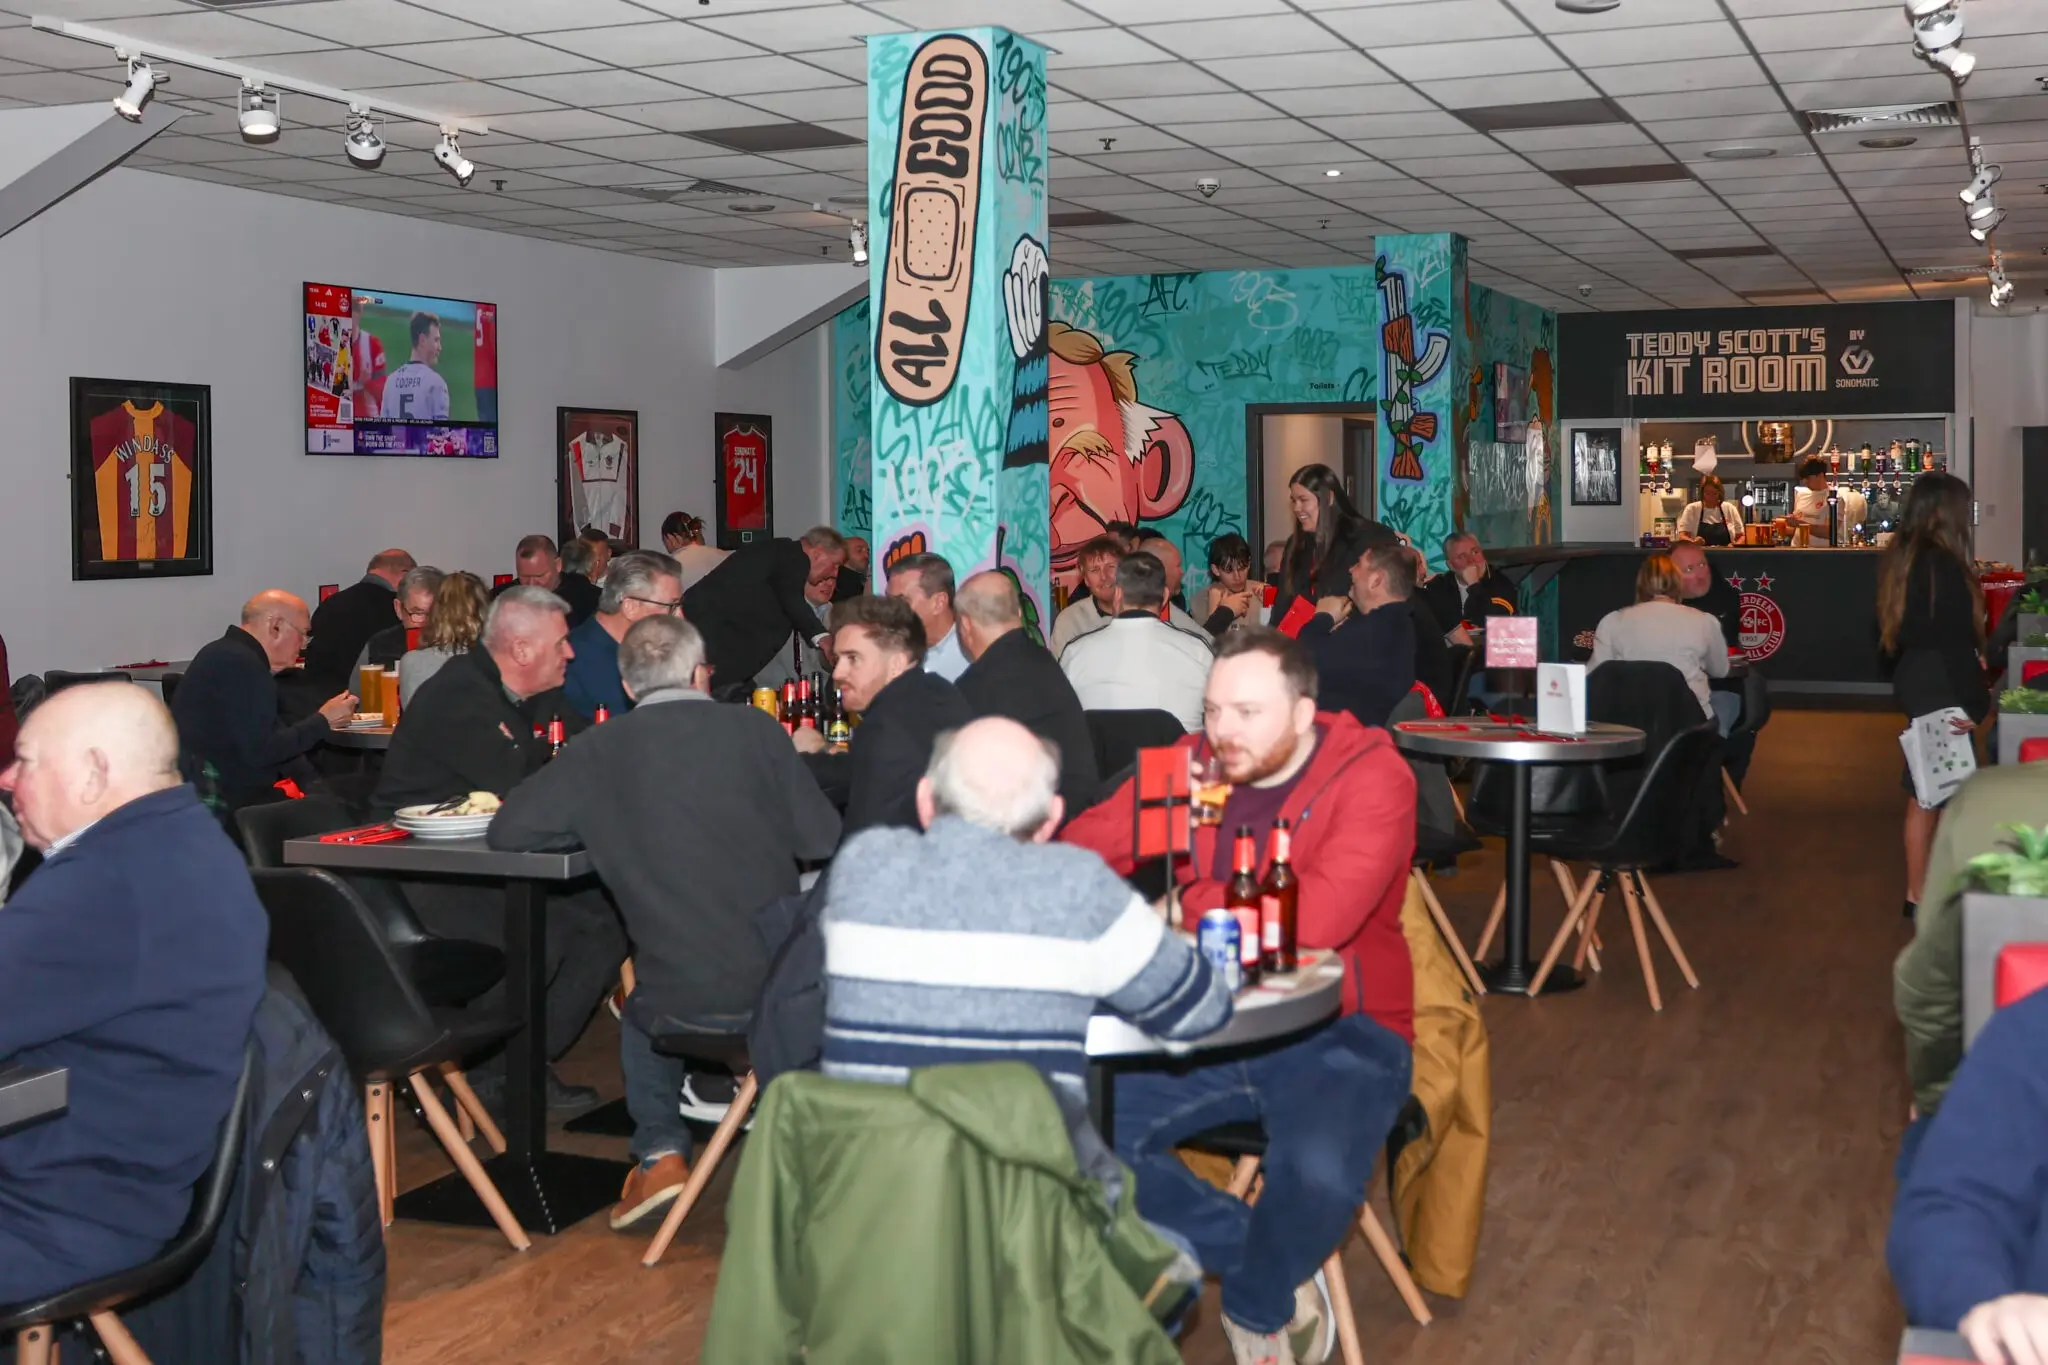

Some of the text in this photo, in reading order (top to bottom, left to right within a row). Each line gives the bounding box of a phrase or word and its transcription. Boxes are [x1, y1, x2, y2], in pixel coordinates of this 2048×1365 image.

[889, 53, 973, 388] ALL GOOD
[1626, 328, 1826, 357] TEDDY SCOTT'S
[1849, 330, 1865, 341] BY
[1196, 344, 1272, 381] TEDDY
[1627, 354, 1827, 395] KIT ROOM
[395, 376, 421, 388] COOPER
[1309, 382, 1335, 390] Toilets
[1835, 378, 1879, 388] SONOMATIC
[115, 436, 174, 464] WINDASS
[733, 457, 757, 494] 24
[125, 464, 167, 517] 15
[1741, 596, 1775, 613] RDEEN
[1763, 630, 1781, 652] CLUB
